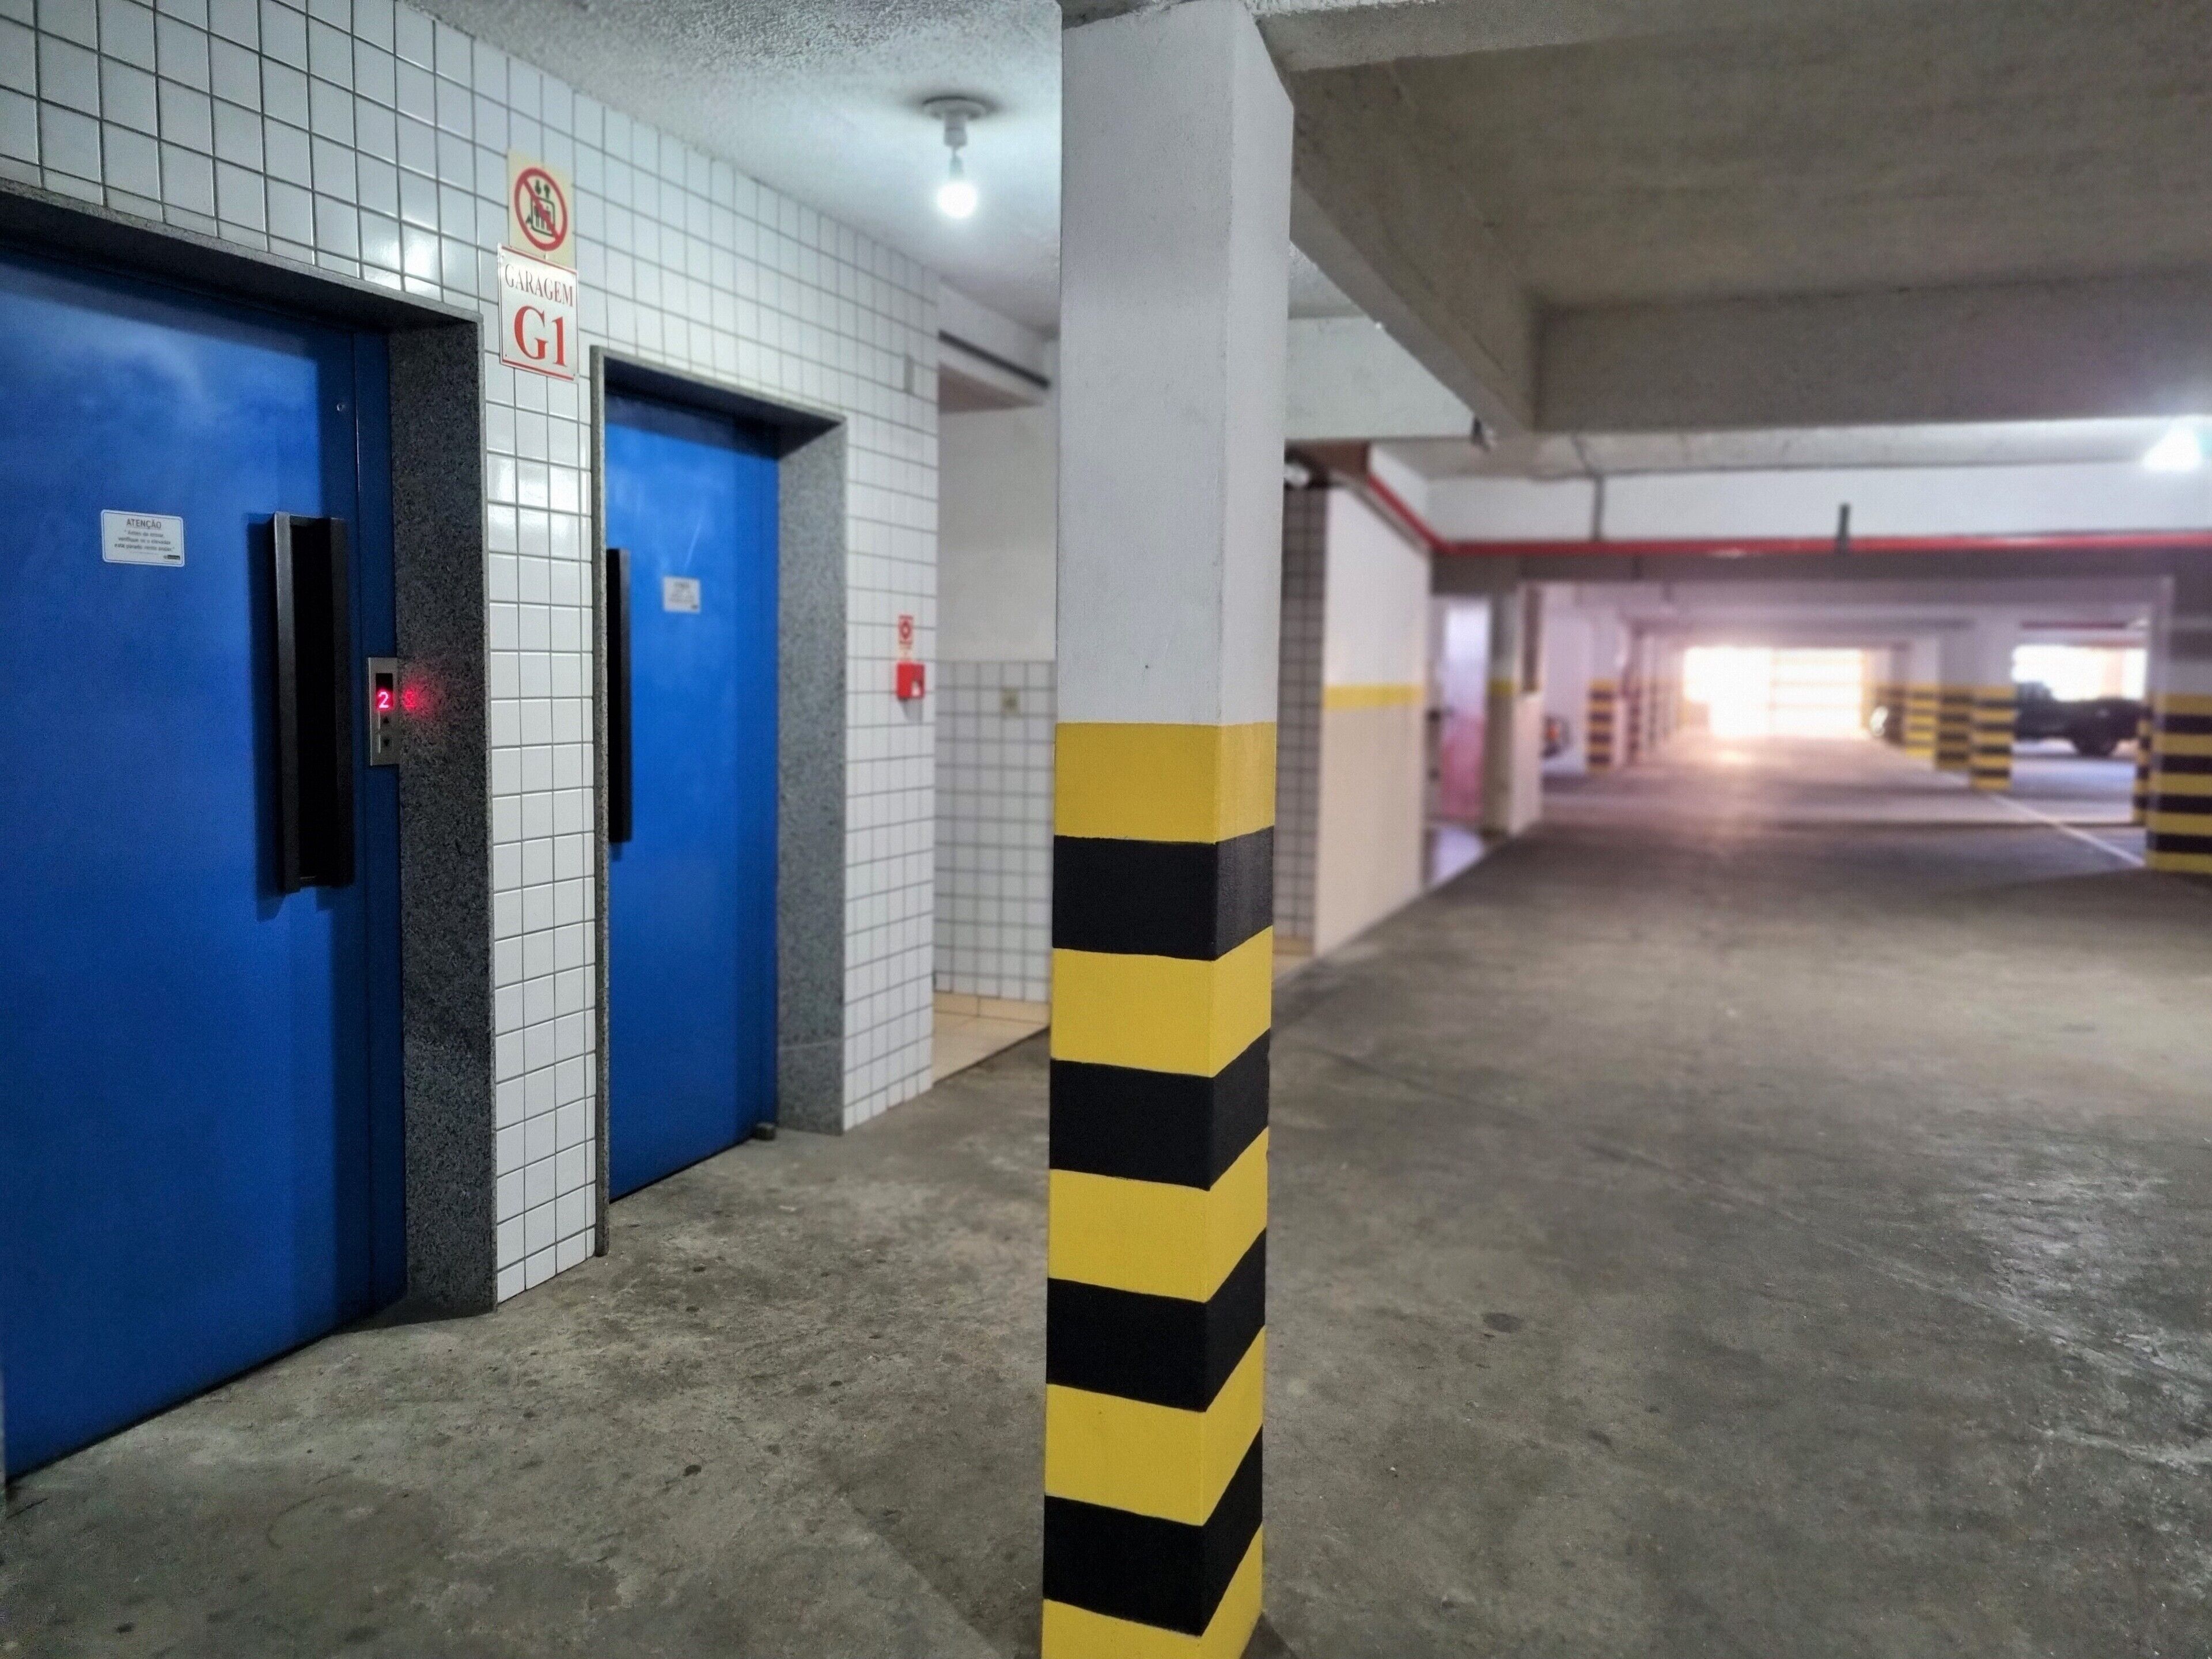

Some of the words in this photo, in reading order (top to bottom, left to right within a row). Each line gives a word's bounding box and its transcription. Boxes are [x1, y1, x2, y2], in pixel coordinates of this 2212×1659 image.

[505, 263, 573, 307] GARAGEM
[514, 305, 569, 368] G1
[127, 518, 161, 529] ATENÇÃO
[378, 691, 389, 709] 2
